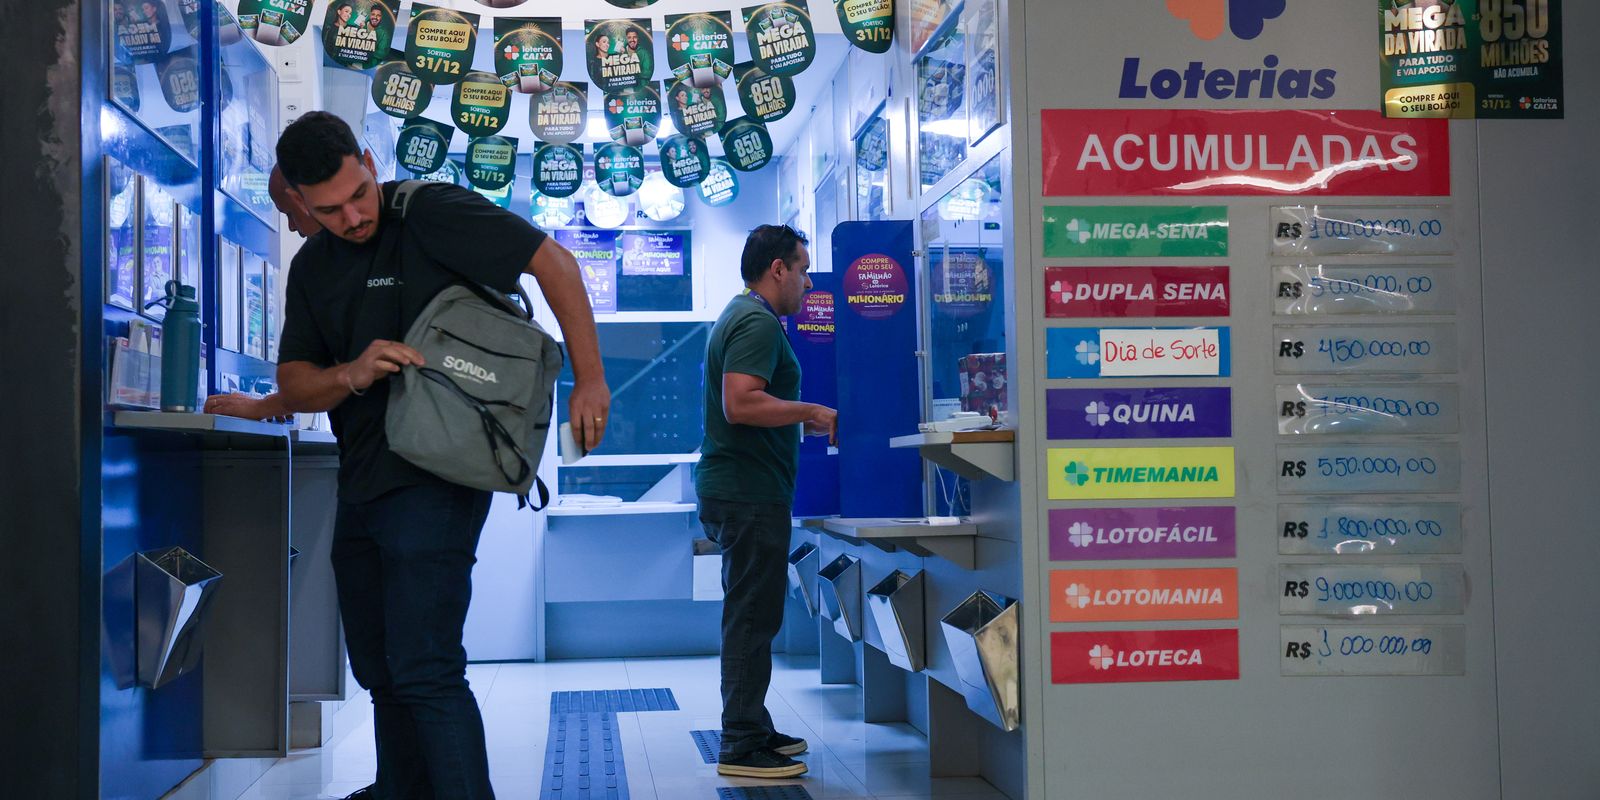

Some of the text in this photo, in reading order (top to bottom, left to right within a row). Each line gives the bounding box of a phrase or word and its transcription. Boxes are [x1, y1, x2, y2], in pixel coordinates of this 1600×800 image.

[847, 2, 872, 12] COMPRE
[868, 4, 889, 12] BOLÃO!
[1385, 2, 1465, 32] MEGA
[1479, 0, 1548, 42] 850
[338, 24, 377, 40] MEGA
[420, 27, 446, 35] COMPRE
[693, 33, 727, 41] loterias
[756, 21, 806, 45] MEGA
[856, 28, 890, 42] 31/12
[335, 36, 376, 52] DA VIRADA
[440, 35, 465, 44] BOLÃO!
[694, 40, 728, 50] CAIXA
[760, 34, 809, 59] DA VIRADA
[1385, 27, 1467, 56] DA VIRADA
[427, 49, 452, 58] SORTEIO
[522, 45, 552, 53] loterias
[1481, 40, 1549, 67] MILHÕES
[416, 56, 460, 74] 31/12
[602, 53, 640, 66] MEGA
[771, 52, 802, 64] PARA TUDO
[1399, 54, 1454, 67] PARA TUDO
[602, 64, 640, 78] DA VIRADA
[1118, 55, 1336, 100] Loterias
[1396, 64, 1457, 77] E VAI APOSTAR!
[1494, 67, 1538, 78] NÃO ACUMULA
[385, 73, 422, 101] 850
[751, 77, 784, 105] 850
[382, 95, 416, 111] MILHÕES
[1400, 92, 1460, 104] COMPRE AQUI
[1482, 100, 1512, 109] 31/12
[538, 102, 581, 114] MEGA
[627, 106, 657, 114] CAIXA
[682, 101, 715, 116] MEGA
[756, 97, 786, 116] MILHÕES
[1410, 104, 1426, 112] SEU
[1428, 101, 1460, 111] BOLÃO!
[460, 112, 498, 128] 31/12
[538, 114, 581, 126] DA VIRADA
[685, 111, 716, 126] DA VIRADA
[408, 136, 438, 159] 850
[735, 131, 763, 157] 850
[740, 150, 766, 167] MILHÕES
[1076, 134, 1418, 171] ACUMULADAS
[405, 154, 433, 169] MILHÕES
[540, 160, 578, 171] MEGA
[673, 156, 699, 168] MEGA
[682, 163, 702, 175] VIRADA
[473, 169, 505, 182] 31/12
[540, 170, 550, 181] DA
[550, 170, 578, 181] VIRADA
[1092, 223, 1208, 239] MEGA-SENA
[1277, 222, 1302, 238] R$
[367, 277, 394, 287] SOND
[1278, 282, 1303, 298] R$
[848, 293, 904, 303] MILIONÁRIO
[1075, 283, 1226, 300] DUPLA SENA
[798, 323, 835, 332] MILIONÁR
[1104, 338, 1217, 362] Dia de Sorte
[1279, 341, 1304, 358] R$
[443, 356, 497, 383] SONDA
[1112, 403, 1196, 425] QUINA
[1282, 401, 1307, 417] R$
[1093, 466, 1218, 483] TIMEMANIA
[1281, 461, 1307, 478] R$
[1096, 523, 1218, 544] LOTOFÁCIL
[1283, 521, 1309, 540] R$
[1093, 588, 1223, 606] LOTOMANIA
[1284, 581, 1310, 599] R$
[1116, 649, 1202, 667] LOTECA
[1286, 642, 1312, 660] R$
